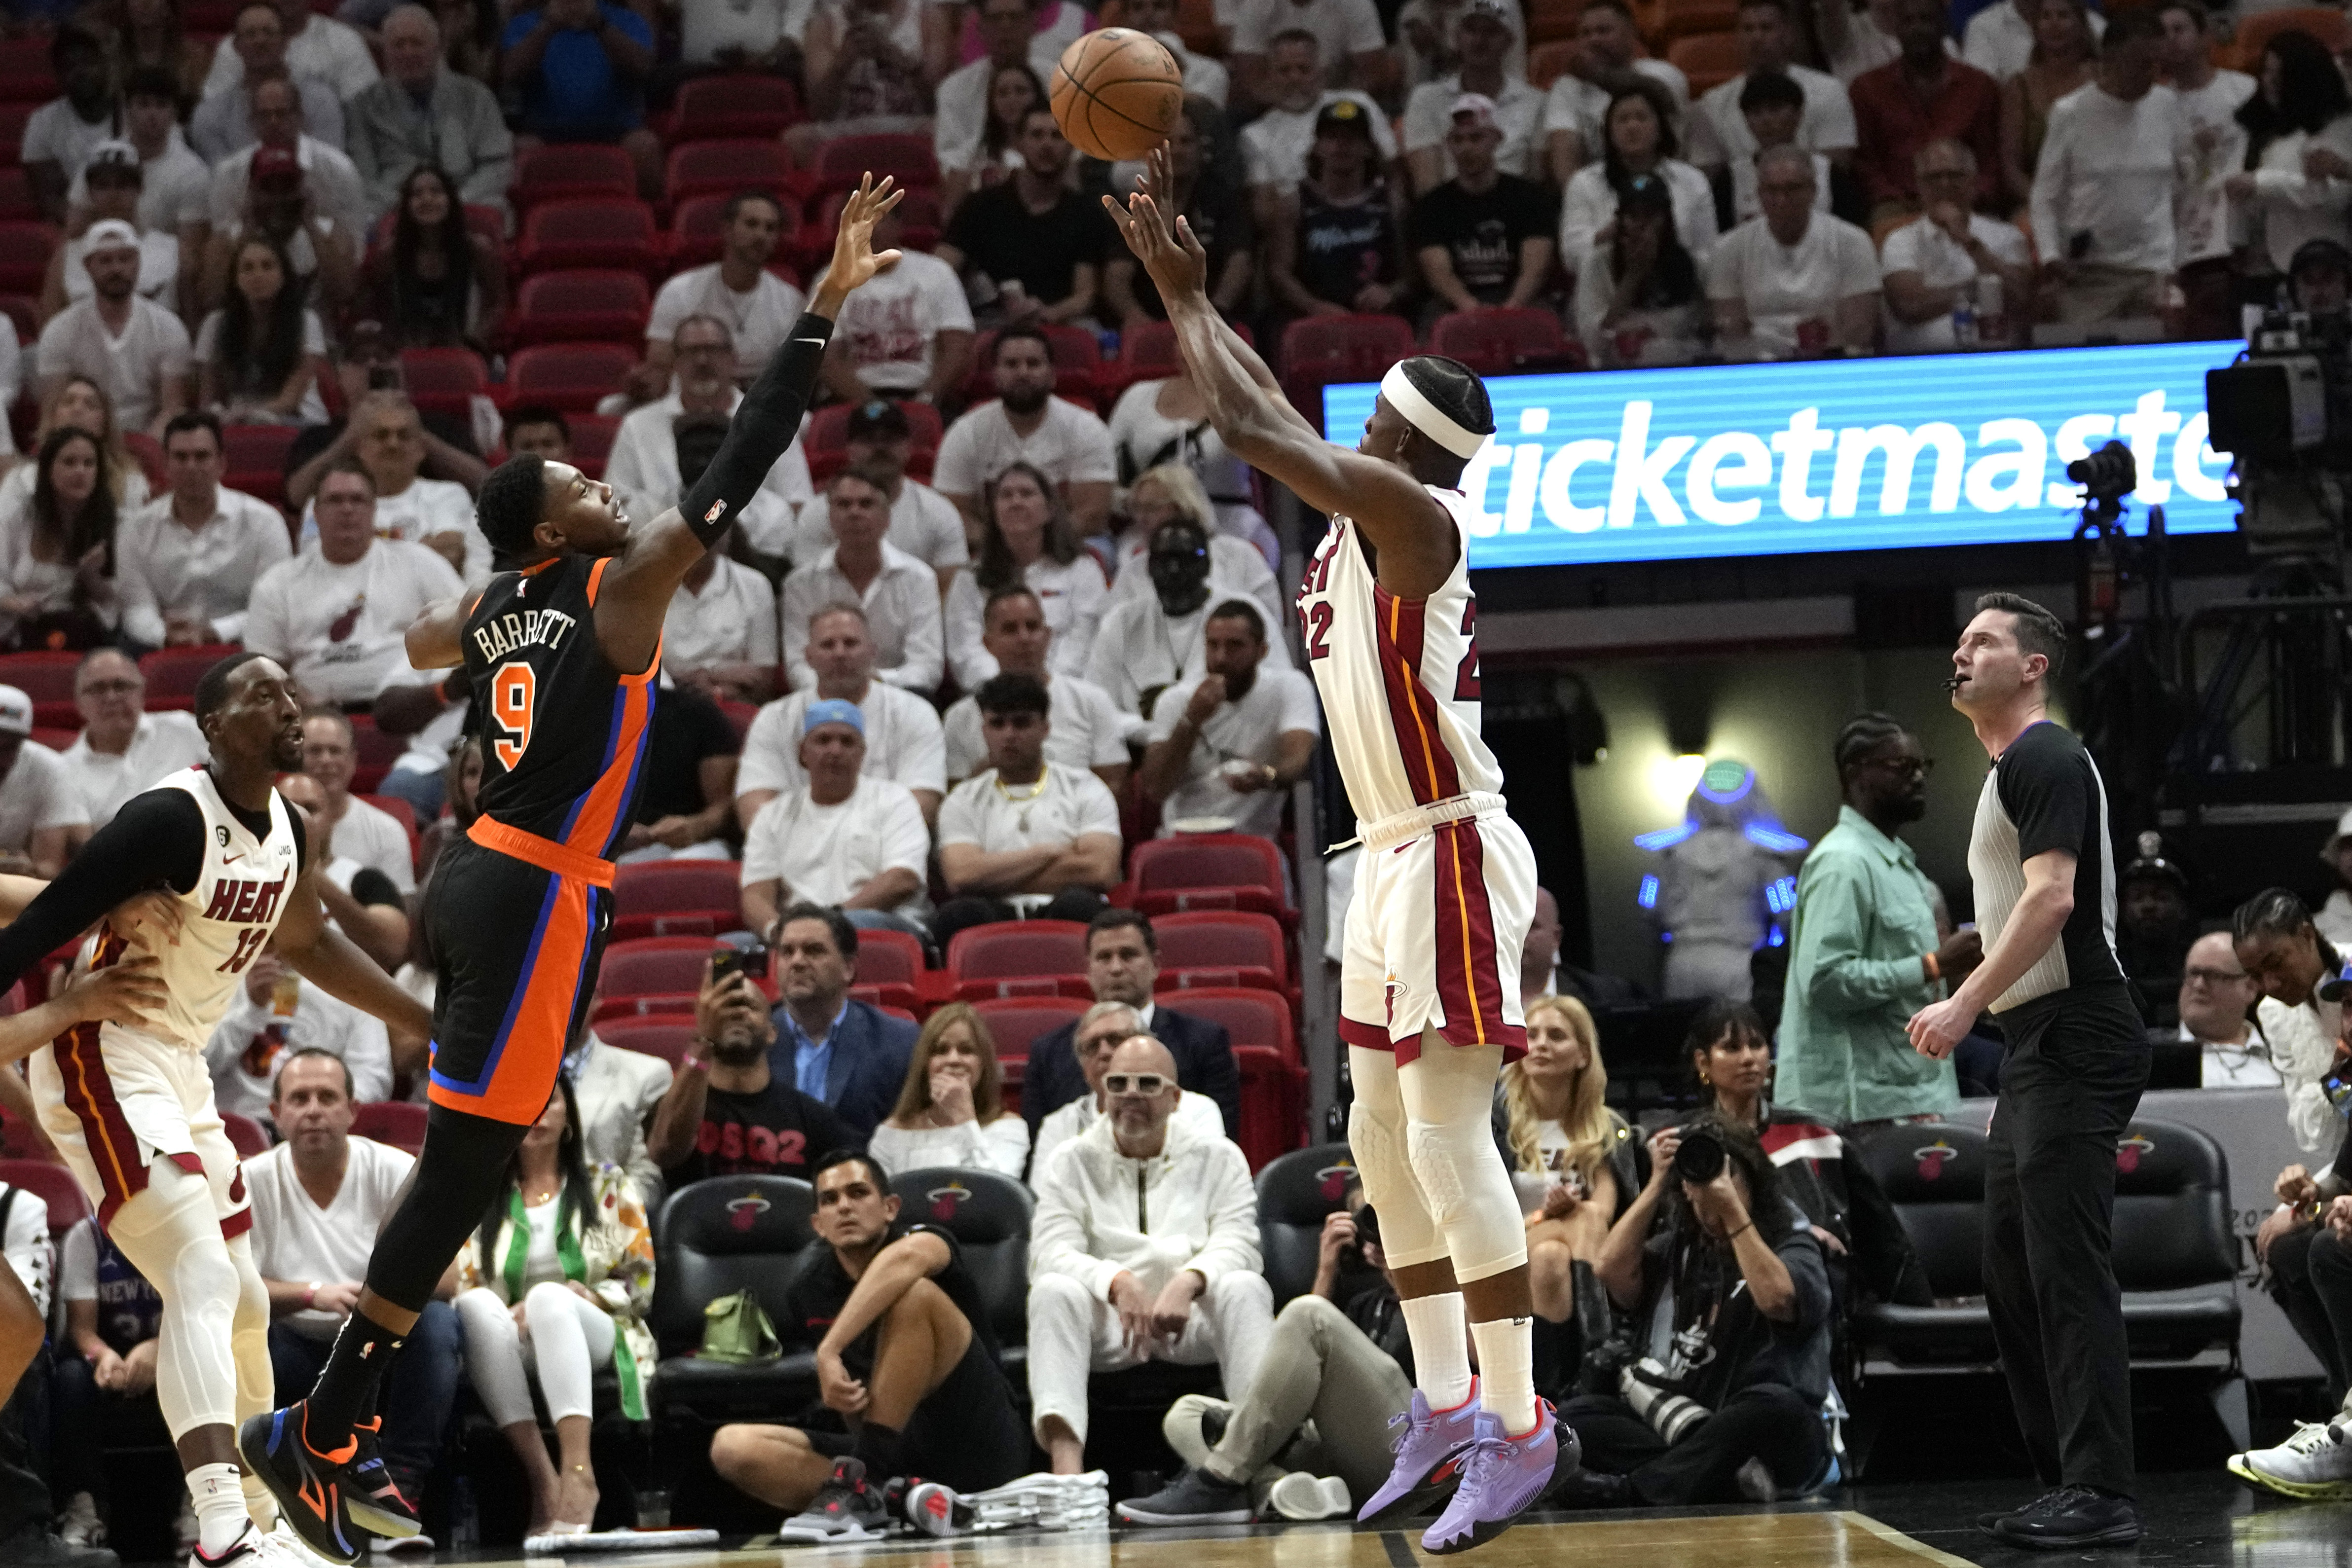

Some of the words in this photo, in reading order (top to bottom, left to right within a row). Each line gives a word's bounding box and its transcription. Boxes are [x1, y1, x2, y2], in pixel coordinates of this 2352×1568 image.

[1457, 389, 2234, 538] ticketmaste
[474, 608, 577, 664] BARRETT
[492, 661, 536, 772] 9
[278, 845, 291, 855] UKG
[202, 862, 290, 923] HEAT
[217, 928, 267, 973] 13
